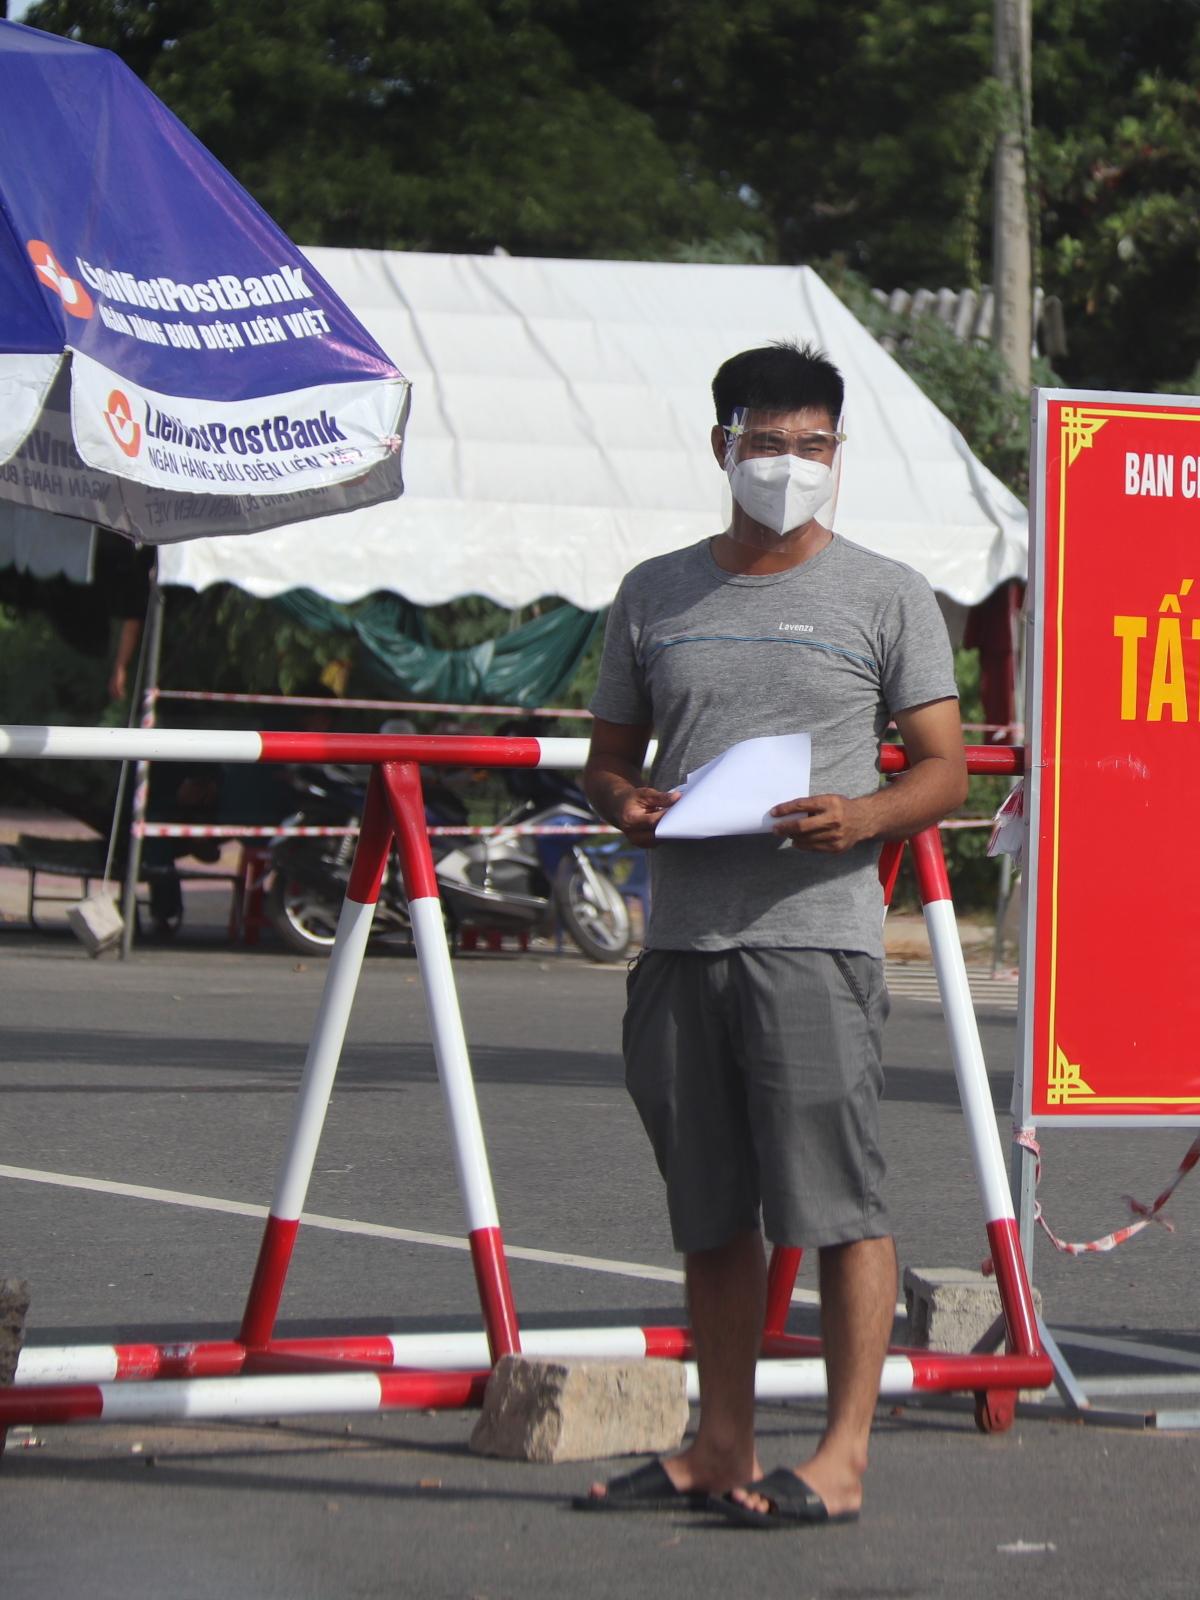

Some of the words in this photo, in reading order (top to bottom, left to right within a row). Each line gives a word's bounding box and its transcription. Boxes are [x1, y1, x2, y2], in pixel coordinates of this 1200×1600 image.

[198, 320, 245, 352] ĐIỆN
[241, 316, 288, 346] LIÊN
[283, 307, 332, 339] VIỆT
[147, 446, 180, 474] NGÂN
[1124, 452, 1174, 497] BAN
[779, 621, 814, 633] Lavenza
